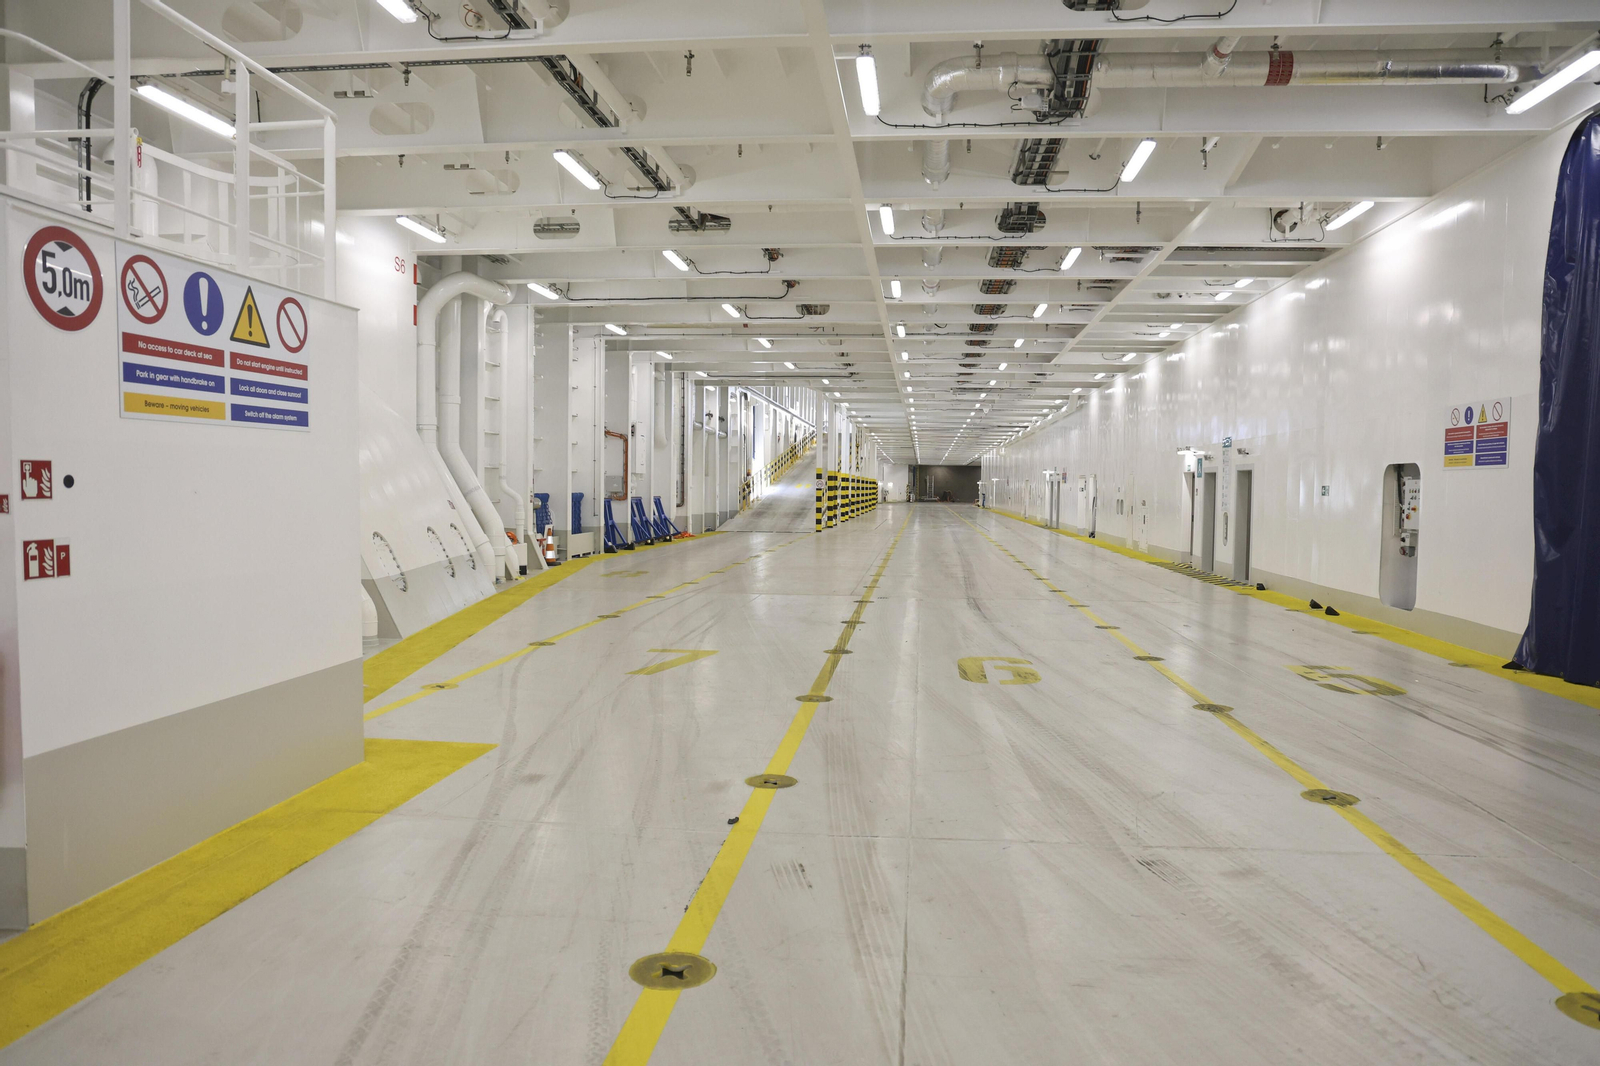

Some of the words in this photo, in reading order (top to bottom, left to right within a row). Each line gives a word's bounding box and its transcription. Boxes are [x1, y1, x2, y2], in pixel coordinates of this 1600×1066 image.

[394, 256, 406, 274] S6
[42, 249, 90, 302] 5,0m
[138, 341, 146, 349] No
[147, 343, 167, 352] access
[167, 346, 173, 354] to
[183, 348, 197, 357] deck
[136, 369, 149, 379] Park
[155, 374, 169, 382] gear
[169, 374, 180, 382] with
[180, 376, 208, 386] handbrake
[261, 363, 275, 371] engine
[284, 367, 303, 376] instructed
[238, 384, 249, 392] Lock
[256, 386, 268, 394] doors
[144, 400, 165, 408] Beware
[170, 404, 189, 412] moving
[190, 404, 210, 413] vehicles
[244, 410, 258, 418] Switch
[60, 552, 66, 560] P
[624, 648, 719, 676] 7
[957, 656, 1042, 685] 6
[1282, 664, 1408, 696] 5
